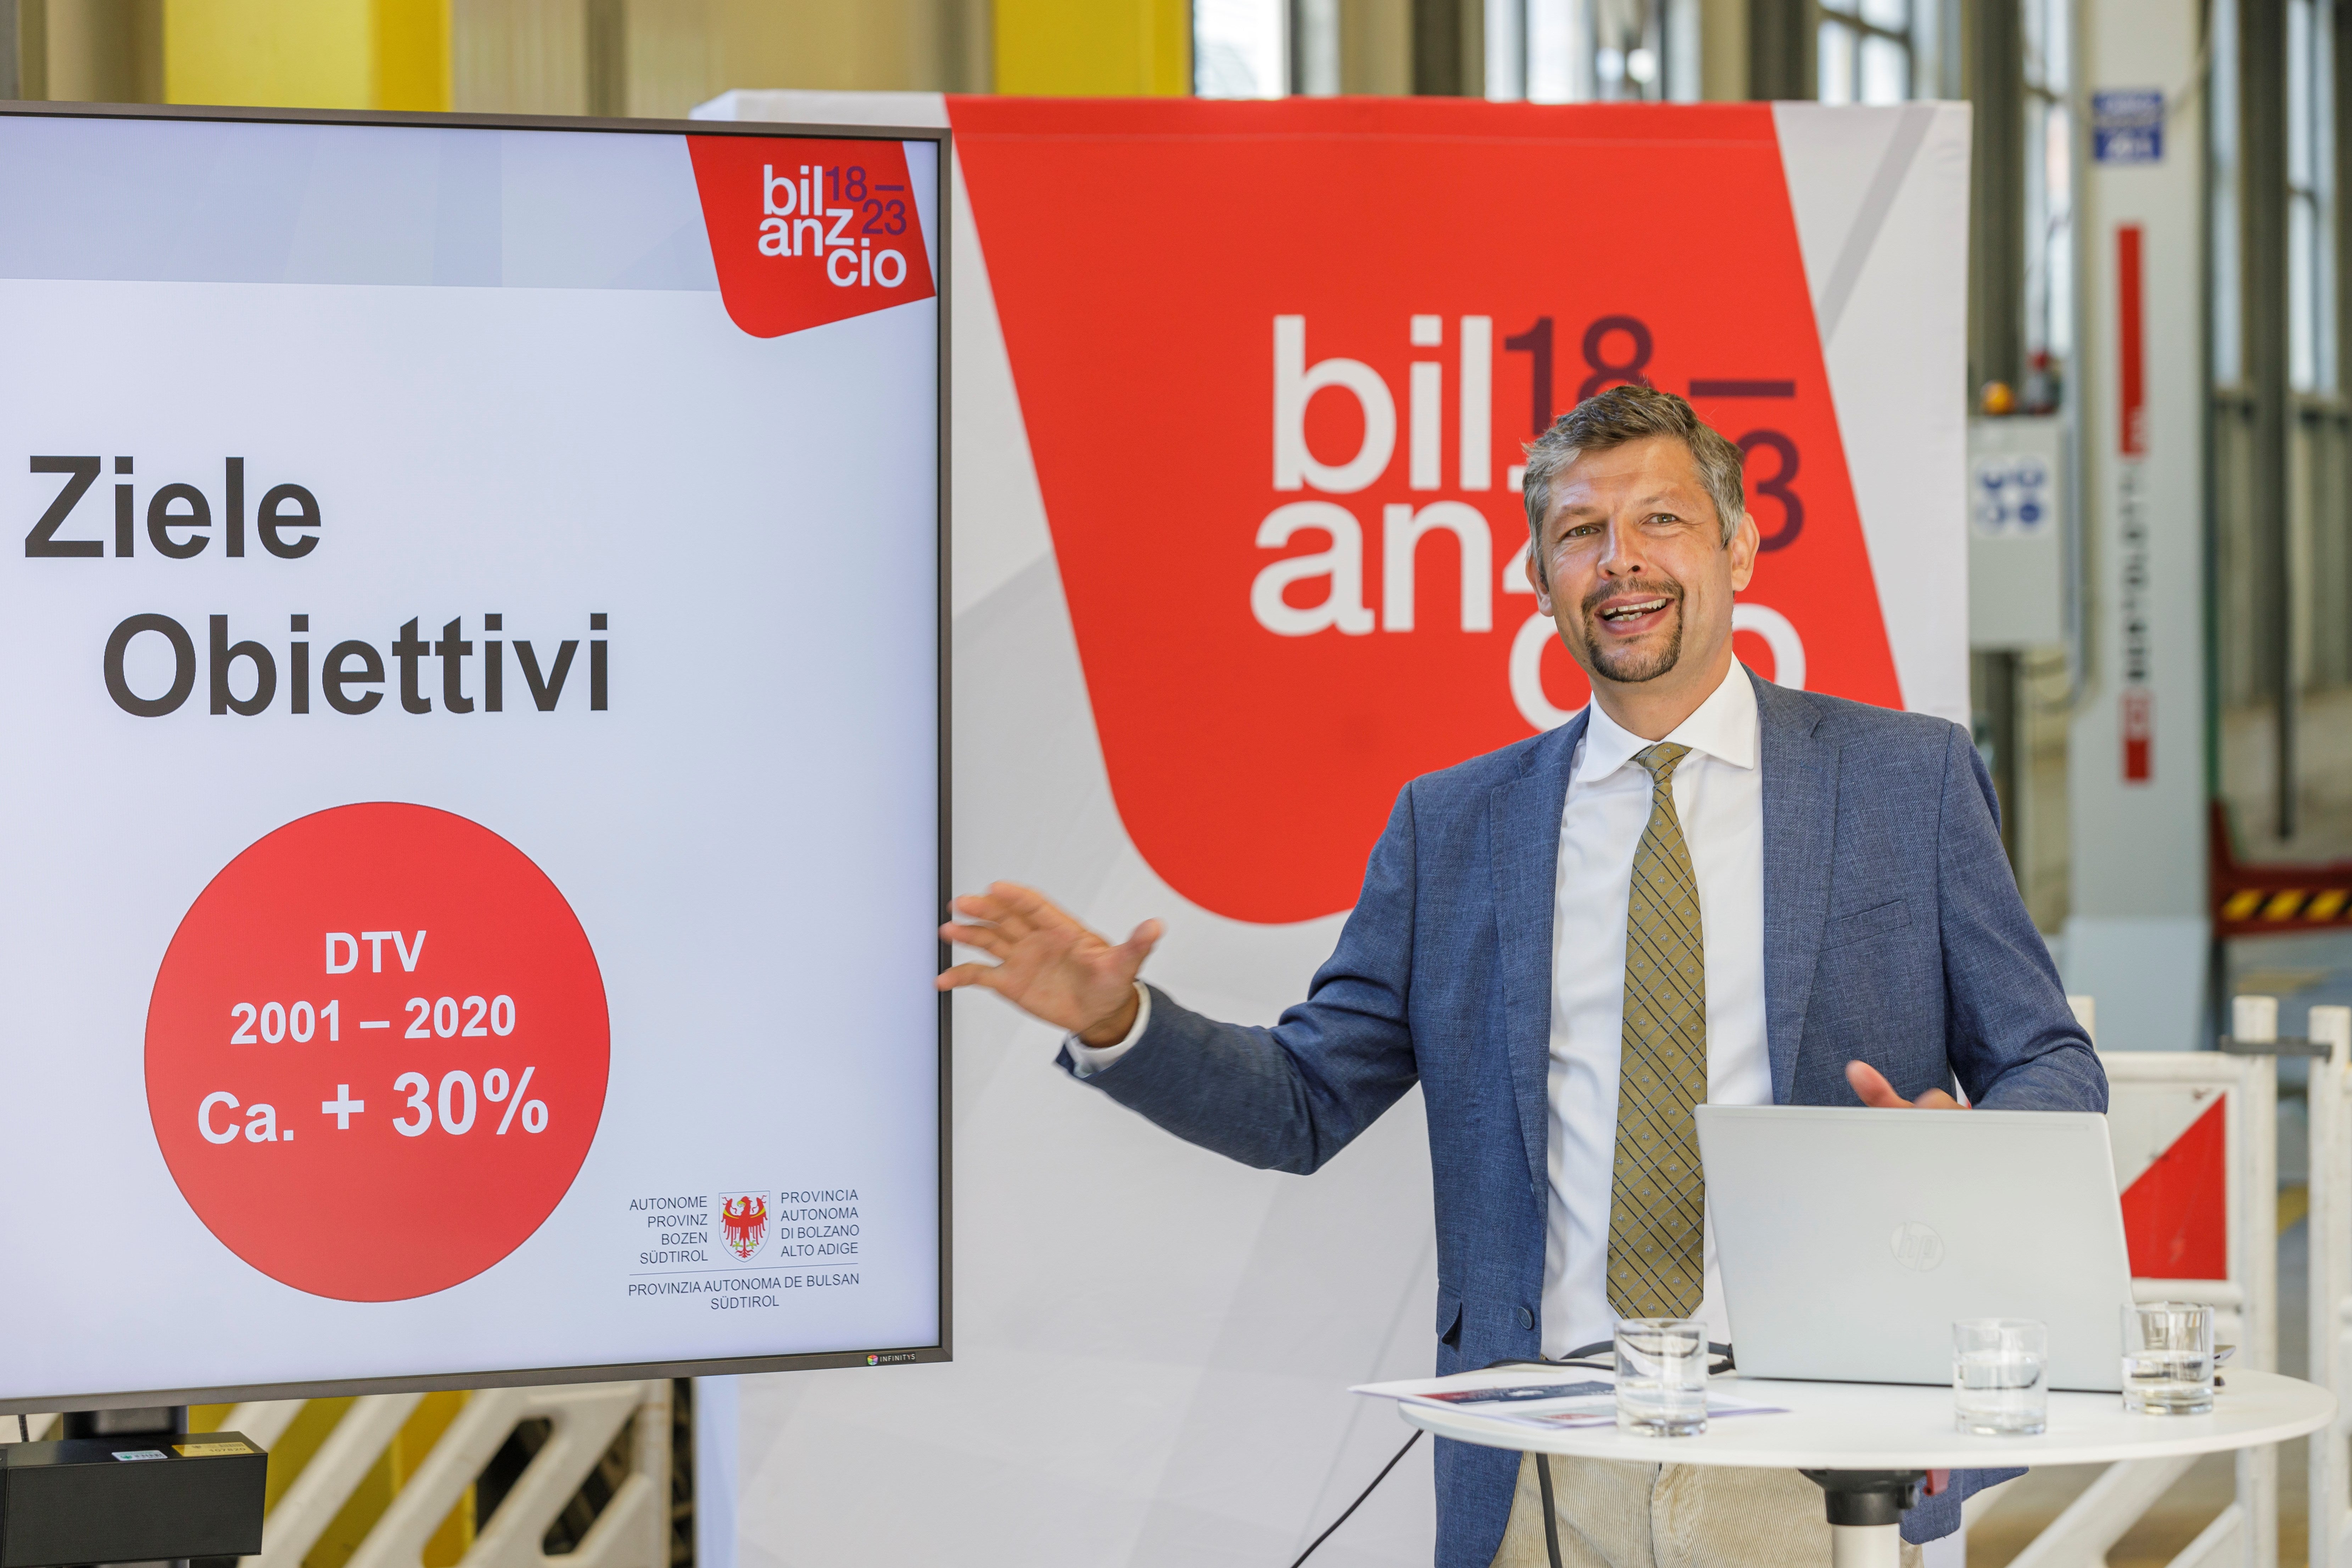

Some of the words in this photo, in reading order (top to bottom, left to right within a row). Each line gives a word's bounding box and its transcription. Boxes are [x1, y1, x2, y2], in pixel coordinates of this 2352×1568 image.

[764, 164, 823, 216] bil
[758, 208, 855, 257] anz
[861, 199, 907, 235] 23
[826, 238, 907, 288] cio
[1273, 315, 1493, 493] bil
[25, 456, 321, 559] Ziele
[1250, 465, 1531, 636] an
[104, 613, 608, 718] Obiettivi
[326, 930, 426, 974] DTV
[230, 1000, 339, 1044] 2001
[404, 994, 515, 1039] 2020
[198, 1091, 294, 1144] Ca.
[392, 1066, 548, 1137] 30%
[629, 1196, 708, 1211] AUTONOME
[781, 1189, 859, 1204] PROVINCIA
[648, 1214, 708, 1228] PROVINZ
[781, 1207, 859, 1222] AUTONOMA
[661, 1232, 708, 1245] BOZEN
[781, 1228, 794, 1239] DI
[798, 1224, 860, 1238] BOLZANO
[1896, 1222, 1939, 1272] hp
[640, 1249, 708, 1264] SÜDTIROL
[781, 1244, 814, 1257] ALTO
[817, 1242, 858, 1255] ADIGE
[629, 1281, 702, 1296] PROVINZIA
[704, 1277, 781, 1292] AUTONOMA
[785, 1276, 803, 1288] DE
[807, 1273, 859, 1287] BULSAN
[711, 1295, 780, 1310] SÜDTIROL
[880, 1354, 916, 1362] INFINITYS
